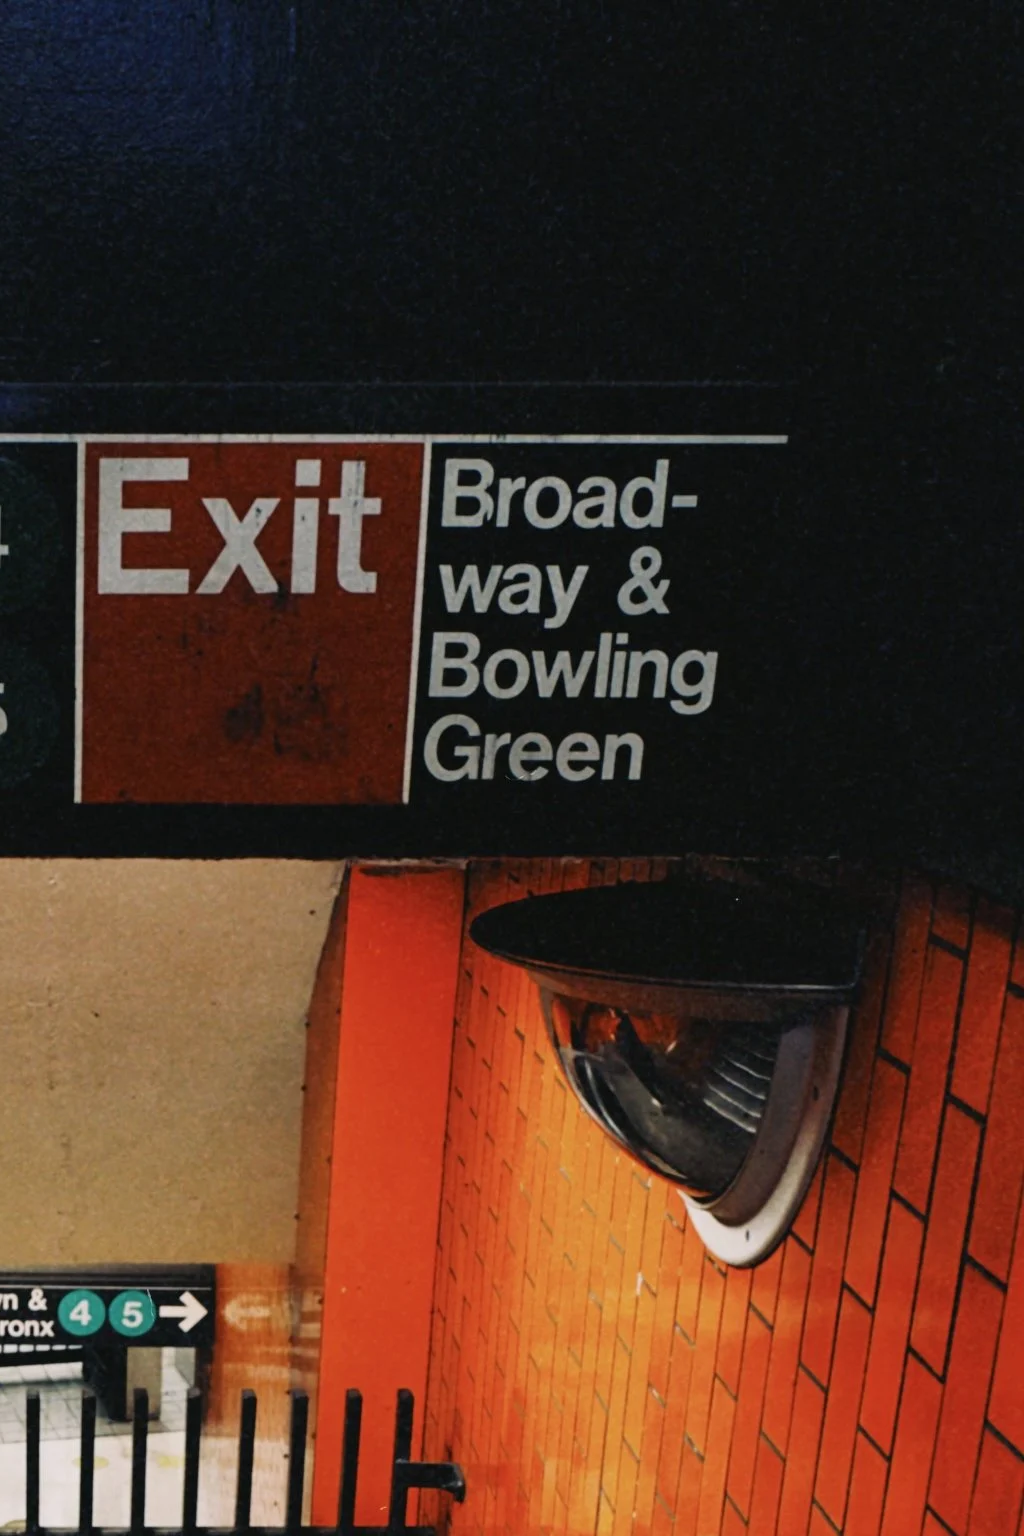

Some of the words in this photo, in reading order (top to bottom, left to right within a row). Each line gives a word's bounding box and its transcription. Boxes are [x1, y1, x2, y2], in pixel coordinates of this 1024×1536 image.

[96, 457, 383, 596] Exit
[440, 458, 699, 530] Broad-
[438, 562, 590, 630] way
[617, 545, 672, 617] &
[427, 631, 720, 716] Bowling
[423, 713, 645, 783] Green
[27, 1286, 48, 1312] &
[68, 1298, 92, 1327] 4
[120, 1300, 144, 1328] 5
